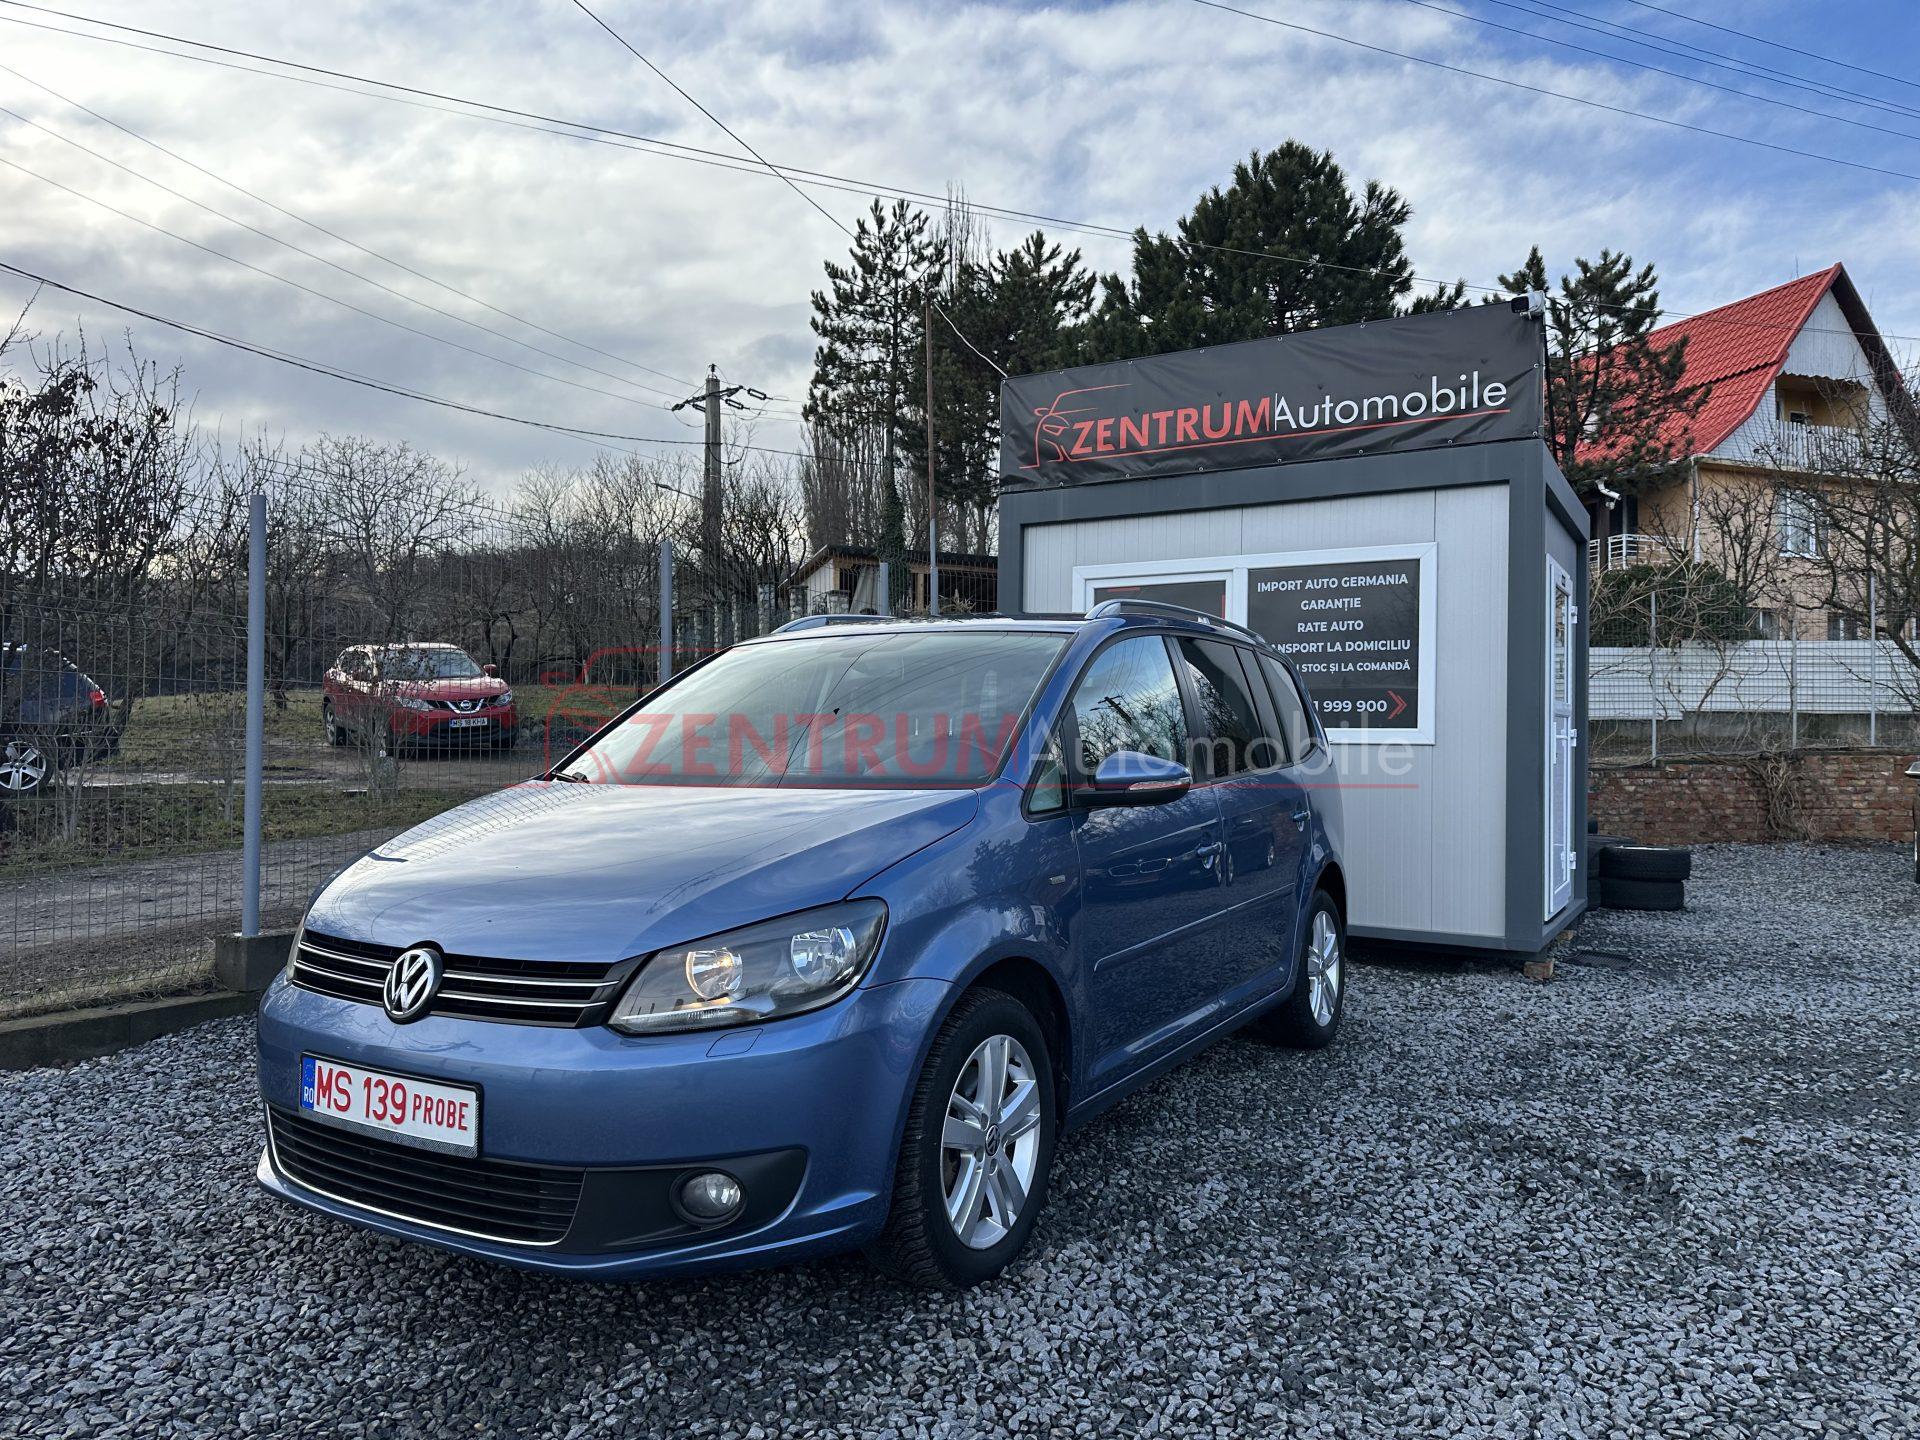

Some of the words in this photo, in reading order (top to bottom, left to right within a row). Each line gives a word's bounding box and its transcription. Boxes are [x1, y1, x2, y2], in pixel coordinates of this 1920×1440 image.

[1070, 397, 1270, 455] ZENTRUM
[1274, 370, 1507, 431] Automobile
[1257, 580, 1302, 592] IMPORT
[1305, 577, 1338, 590] AUTO
[1341, 573, 1408, 588] GERMANIA
[1297, 621, 1327, 633] RATE
[1330, 620, 1364, 632] AUTO
[1271, 642, 1324, 654] NSPORT
[1326, 641, 1342, 652] LA
[1345, 639, 1411, 652] DOMICILIU
[1301, 663, 1327, 672] STOC
[1341, 662, 1354, 671] LA
[1323, 700, 1352, 712] 999
[1356, 700, 1388, 712] 900
[303, 1086, 314, 1103] RO
[316, 1065, 352, 1112] MS
[363, 1076, 407, 1125] 139
[412, 1093, 469, 1131] PROBE
